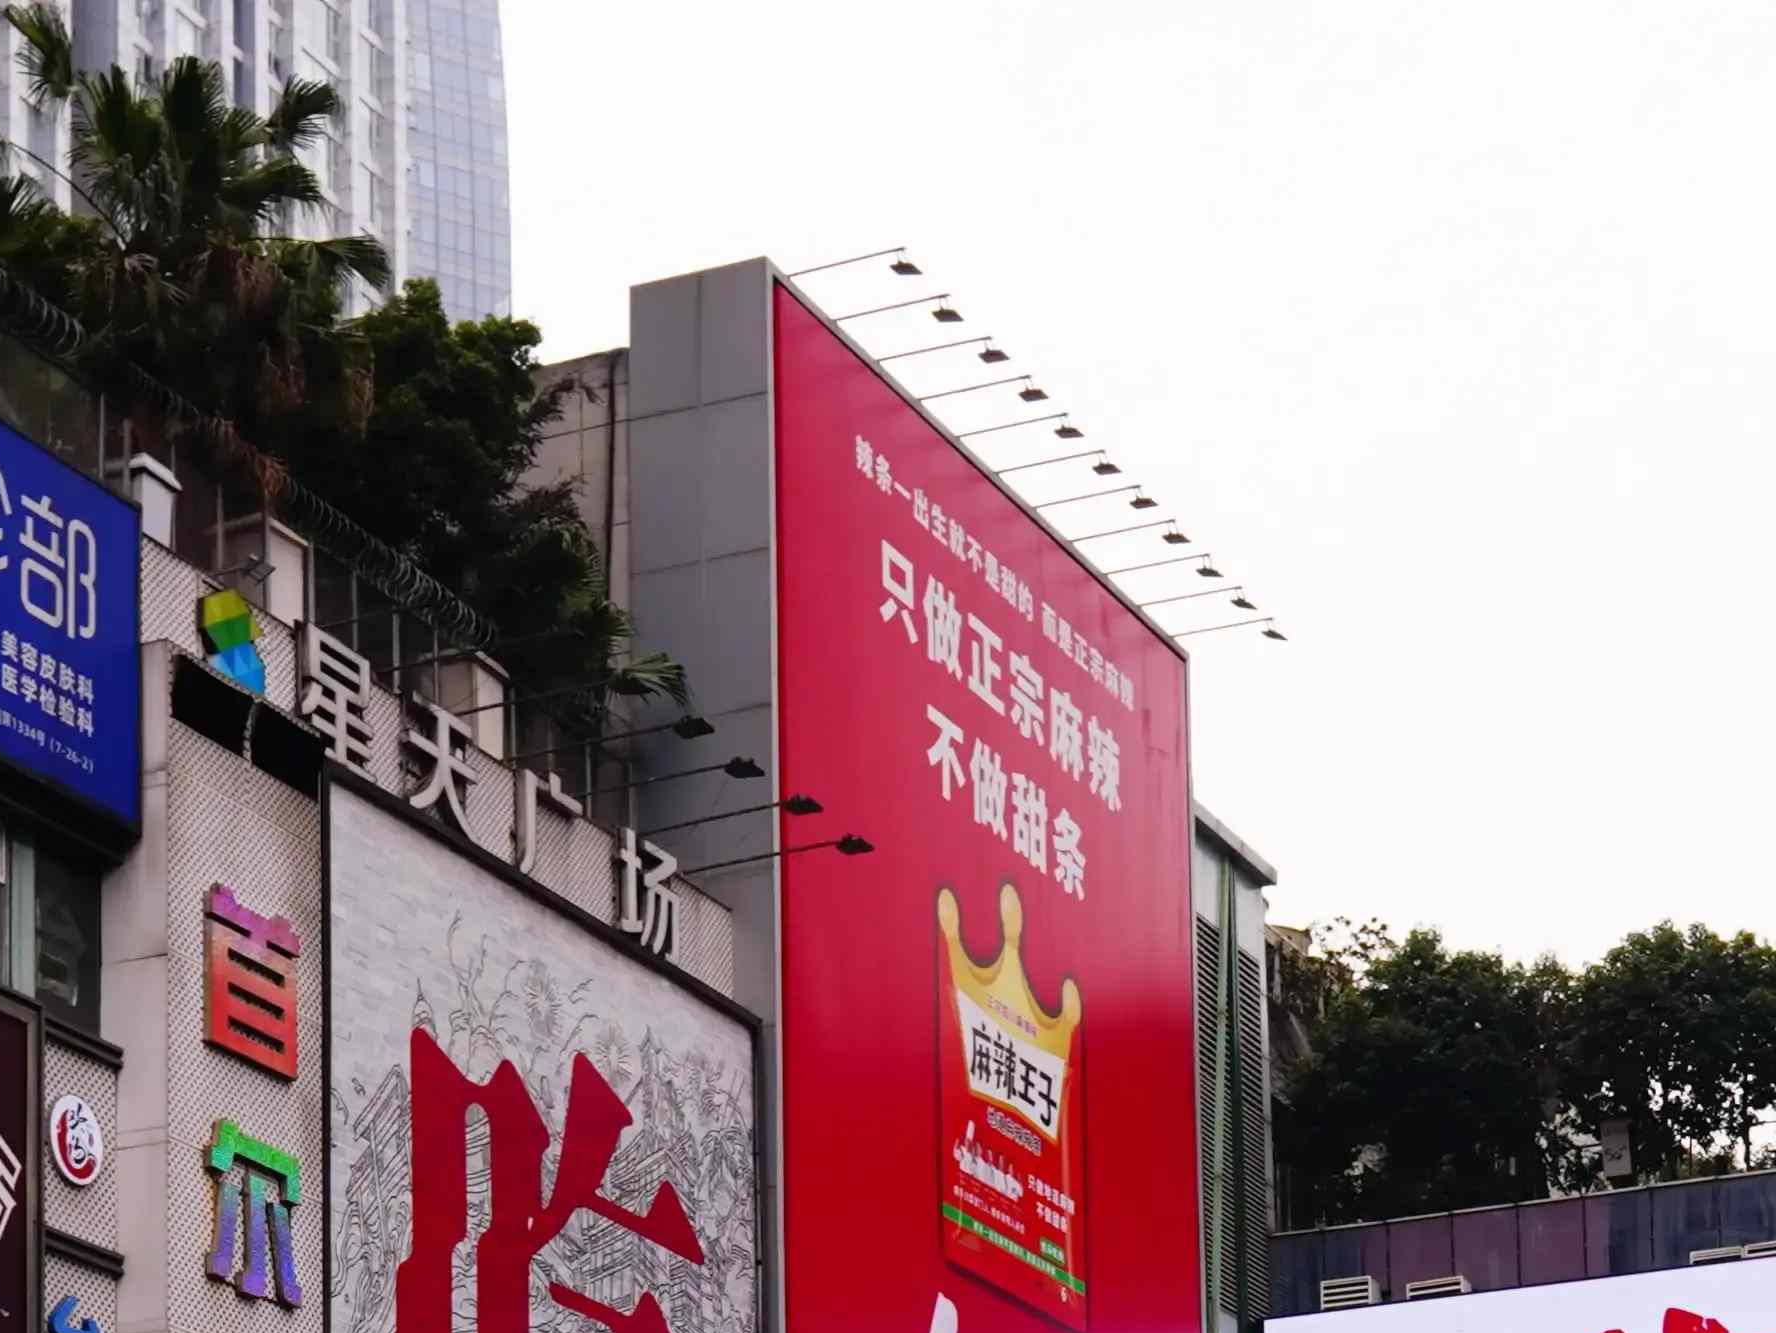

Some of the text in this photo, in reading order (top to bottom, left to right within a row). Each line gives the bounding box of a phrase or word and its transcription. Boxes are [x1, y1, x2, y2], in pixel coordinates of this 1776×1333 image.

[855, 434, 1036, 624] 辣条一出生就不是甜的
[0, 629, 94, 706] 美容皮肤科
[0, 662, 94, 739] 医学检验科
[880, 538, 1122, 813] 只做正宗麻辣
[303, 620, 681, 962] 星天广场
[926, 703, 1087, 900] 不做甜条
[970, 1021, 1058, 1127] 麻辣王子
